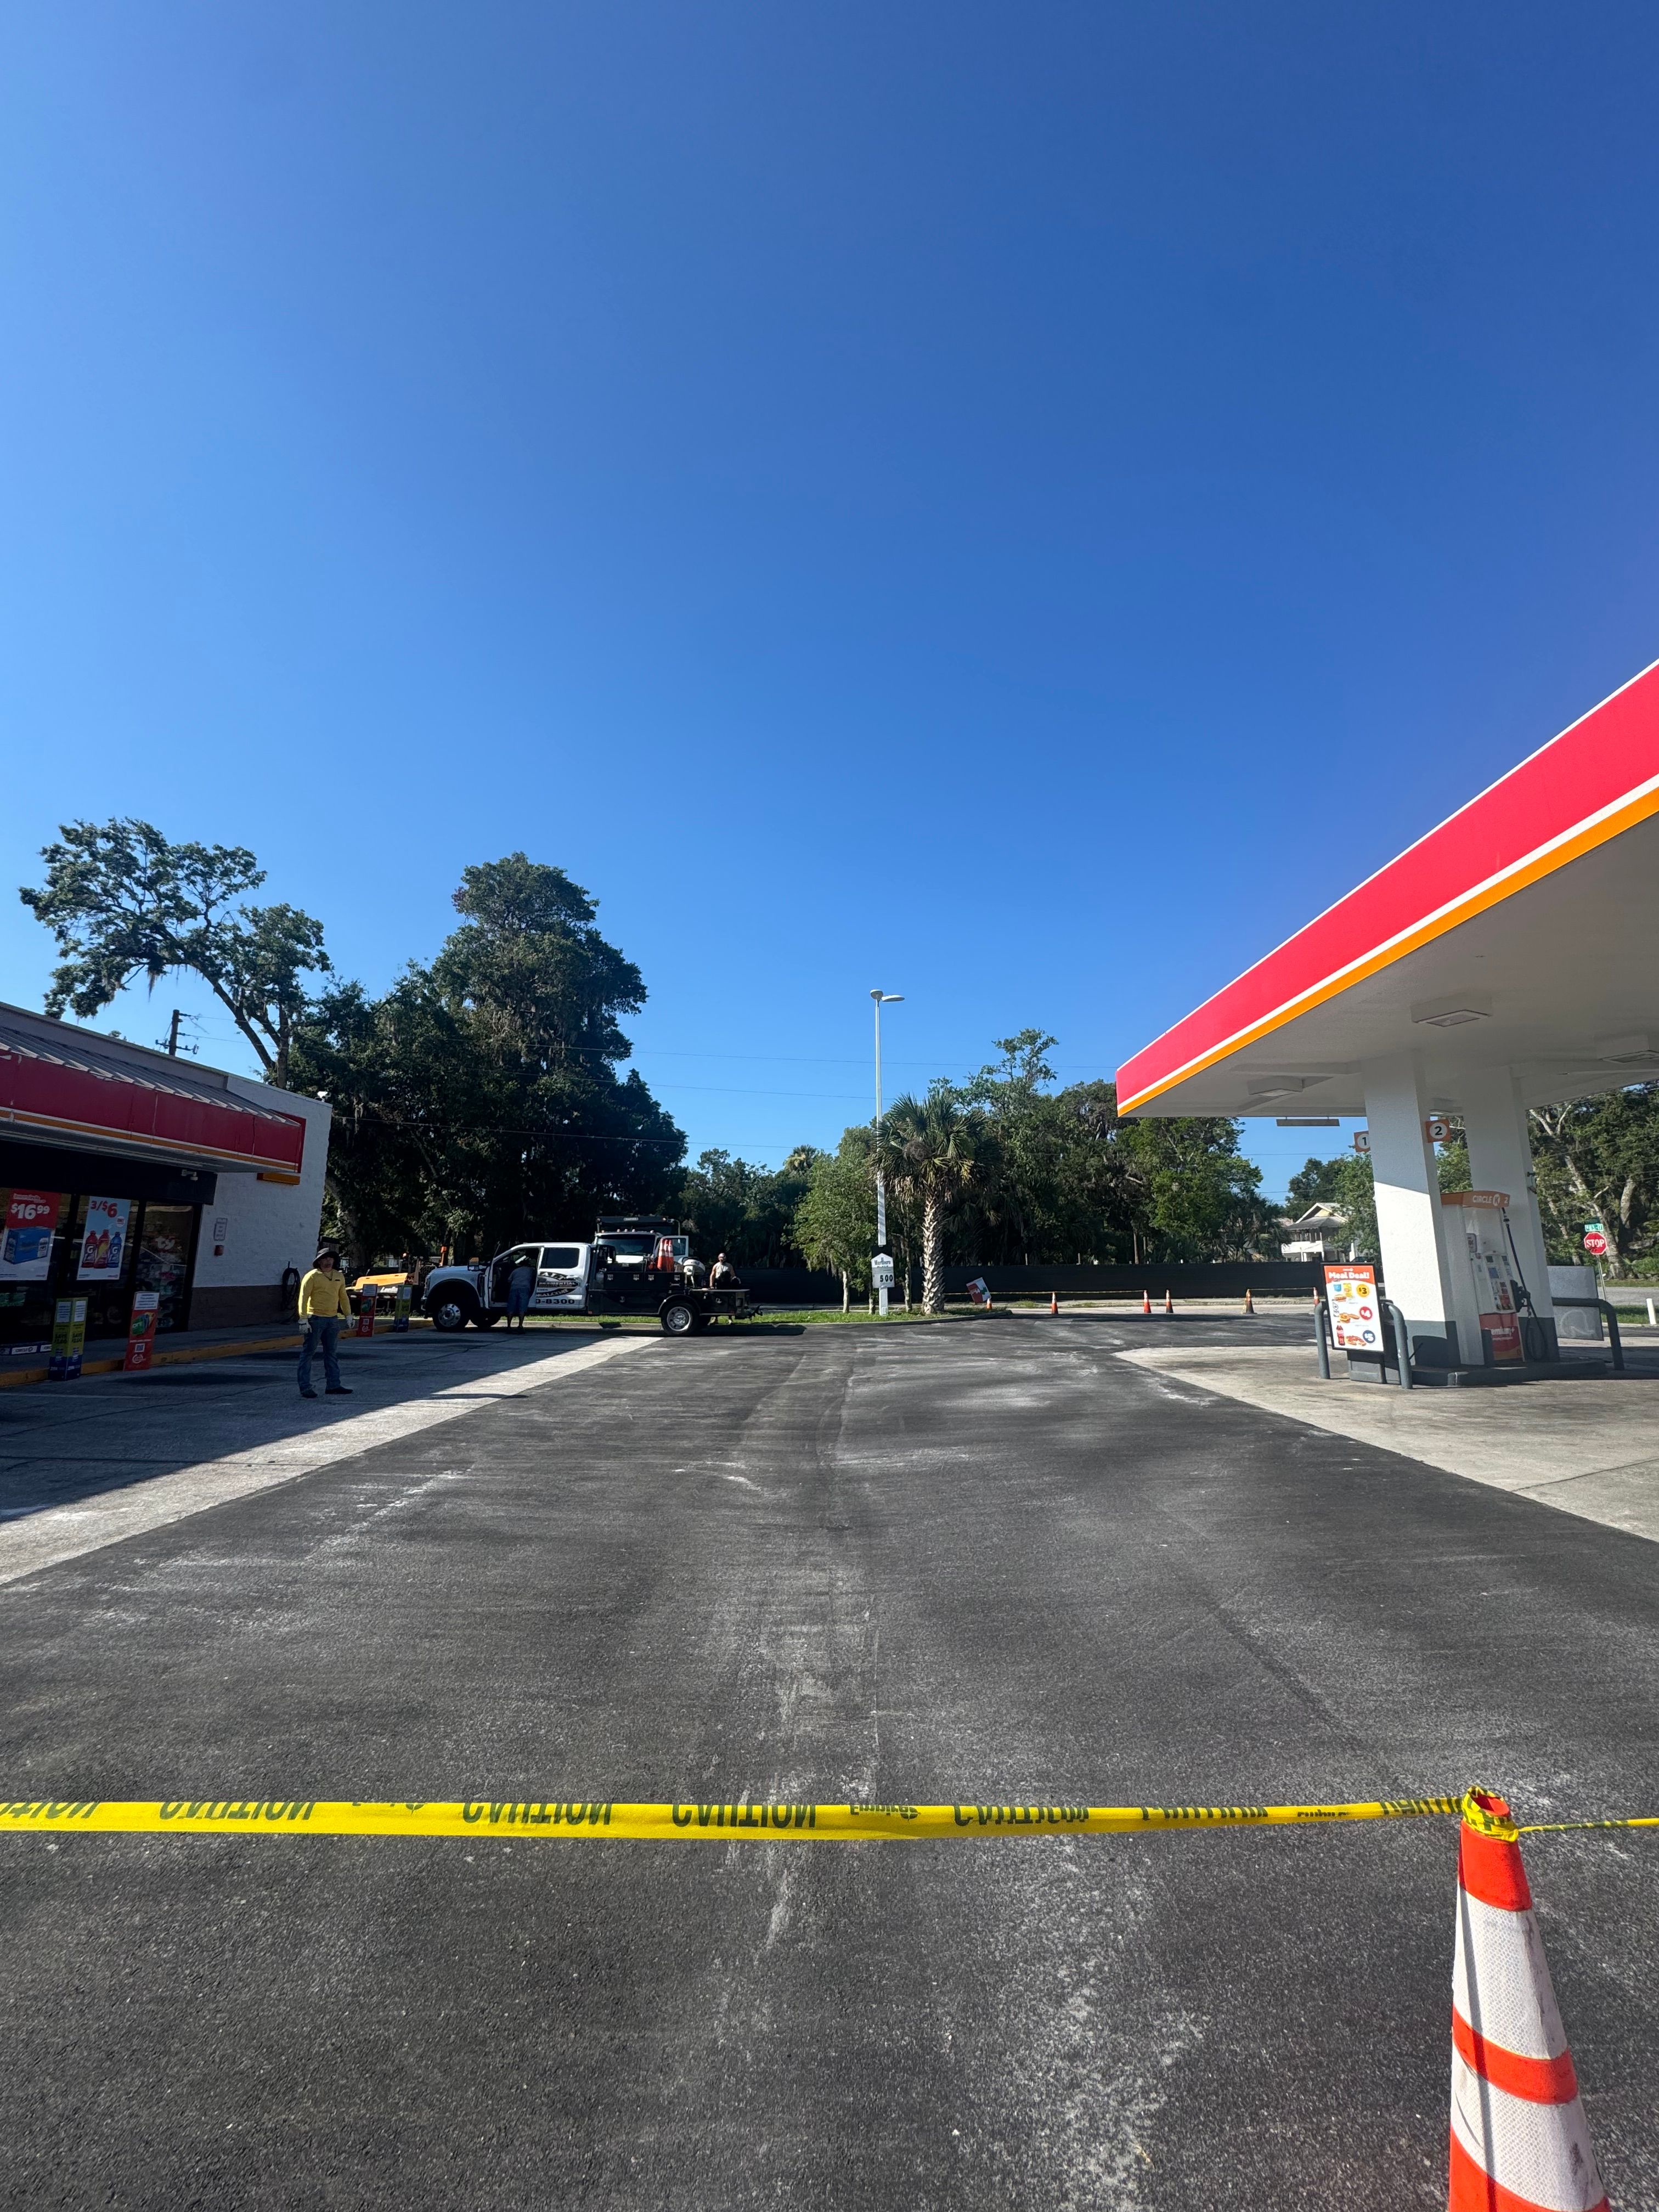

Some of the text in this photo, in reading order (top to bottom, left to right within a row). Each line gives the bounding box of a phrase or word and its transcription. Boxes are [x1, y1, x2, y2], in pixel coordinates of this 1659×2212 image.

[1434, 1126, 1443, 1136] 2
[1362, 1137, 1367, 1146] 1
[1472, 1195, 1492, 1203] CIRCLE
[1586, 1239, 1605, 1248] STOP
[880, 1274, 893, 1283] 500
[1365, 1333, 1374, 1341] $5
